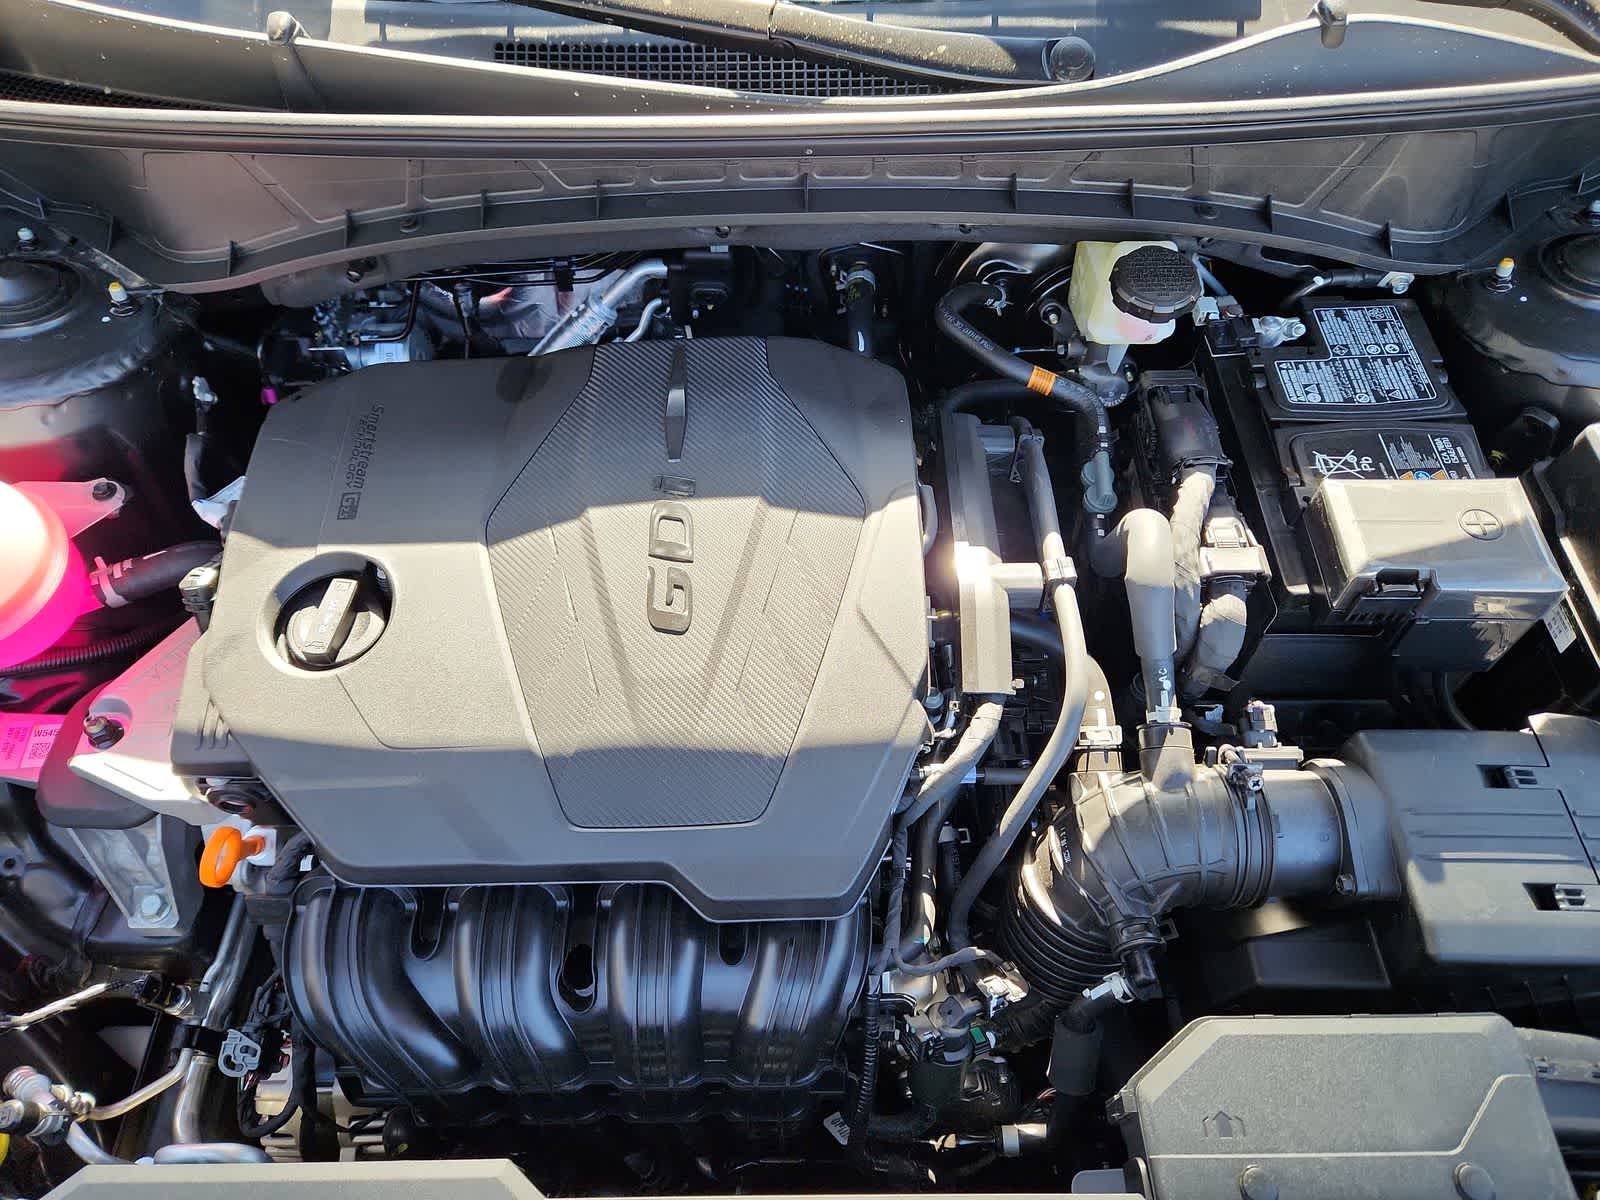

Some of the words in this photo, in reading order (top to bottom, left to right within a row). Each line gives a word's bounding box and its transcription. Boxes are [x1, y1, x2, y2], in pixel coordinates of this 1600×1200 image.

[353, 404, 384, 489] Smartstream
[1360, 456, 1376, 472] Pb
[1440, 452, 1452, 464] CCA
[648, 474, 695, 636] GDI
